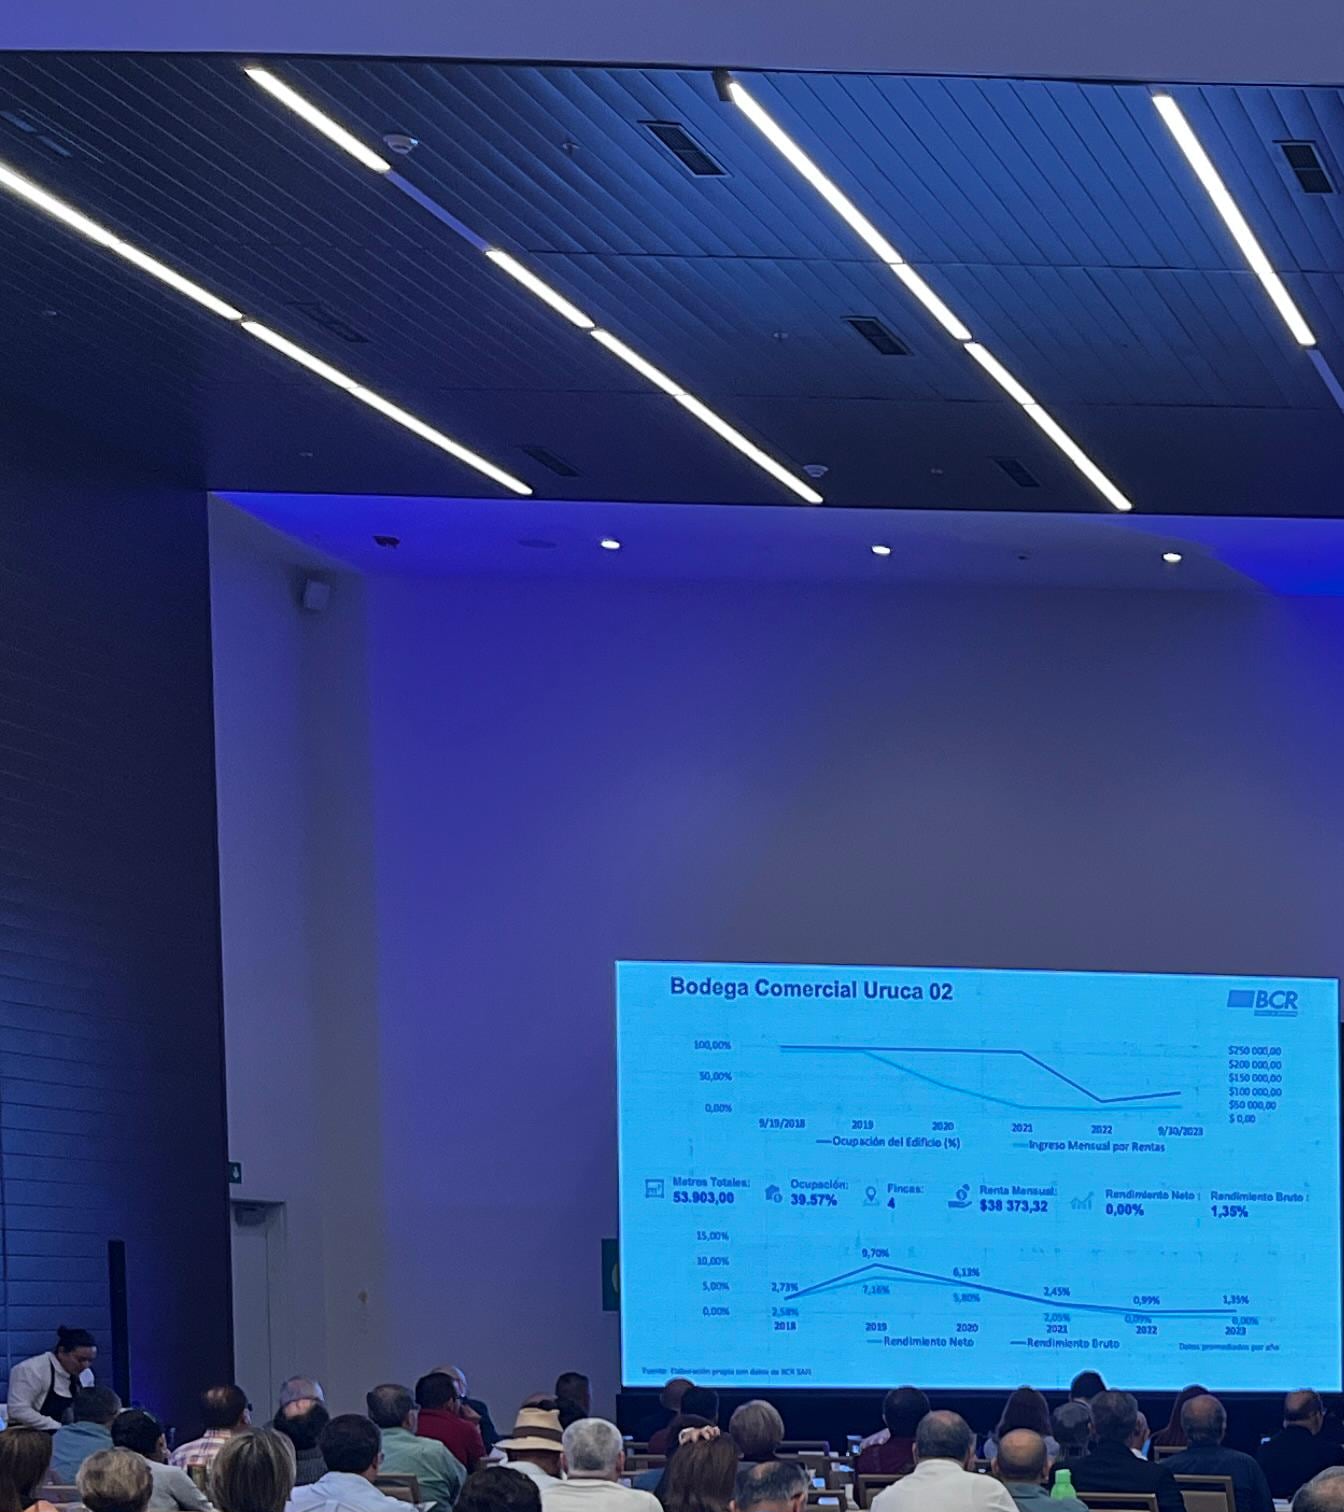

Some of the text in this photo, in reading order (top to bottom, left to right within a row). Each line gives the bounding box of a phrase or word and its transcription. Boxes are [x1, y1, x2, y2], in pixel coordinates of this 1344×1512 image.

[671, 977, 953, 1000] Bodega Comercial Uruca 02
[1256, 990, 1298, 1009] BCR
[852, 1120, 873, 1130] 2019
[932, 1121, 954, 1131] 2020
[1012, 1124, 1033, 1133] 2021
[833, 1136, 960, 1149] Ocupación del Edificio (%)
[1029, 1140, 1165, 1153] Ingreso Mensual por Rentas
[673, 1177, 708, 1187] Metros
[980, 1185, 1009, 1195] Renta
[1105, 1190, 1169, 1200] Rendimiento
[673, 1192, 734, 1205] 53.903,00
[791, 1194, 837, 1206] 39.57%
[1211, 1192, 1273, 1201] Rendimiento
[888, 1198, 895, 1208] 4
[1105, 1204, 1144, 1217] 0,00%
[1211, 1206, 1249, 1218] 1,35%
[884, 1336, 974, 1347] Rendimiento Neto
[1028, 1339, 1120, 1348] Rendimiento Bruto
